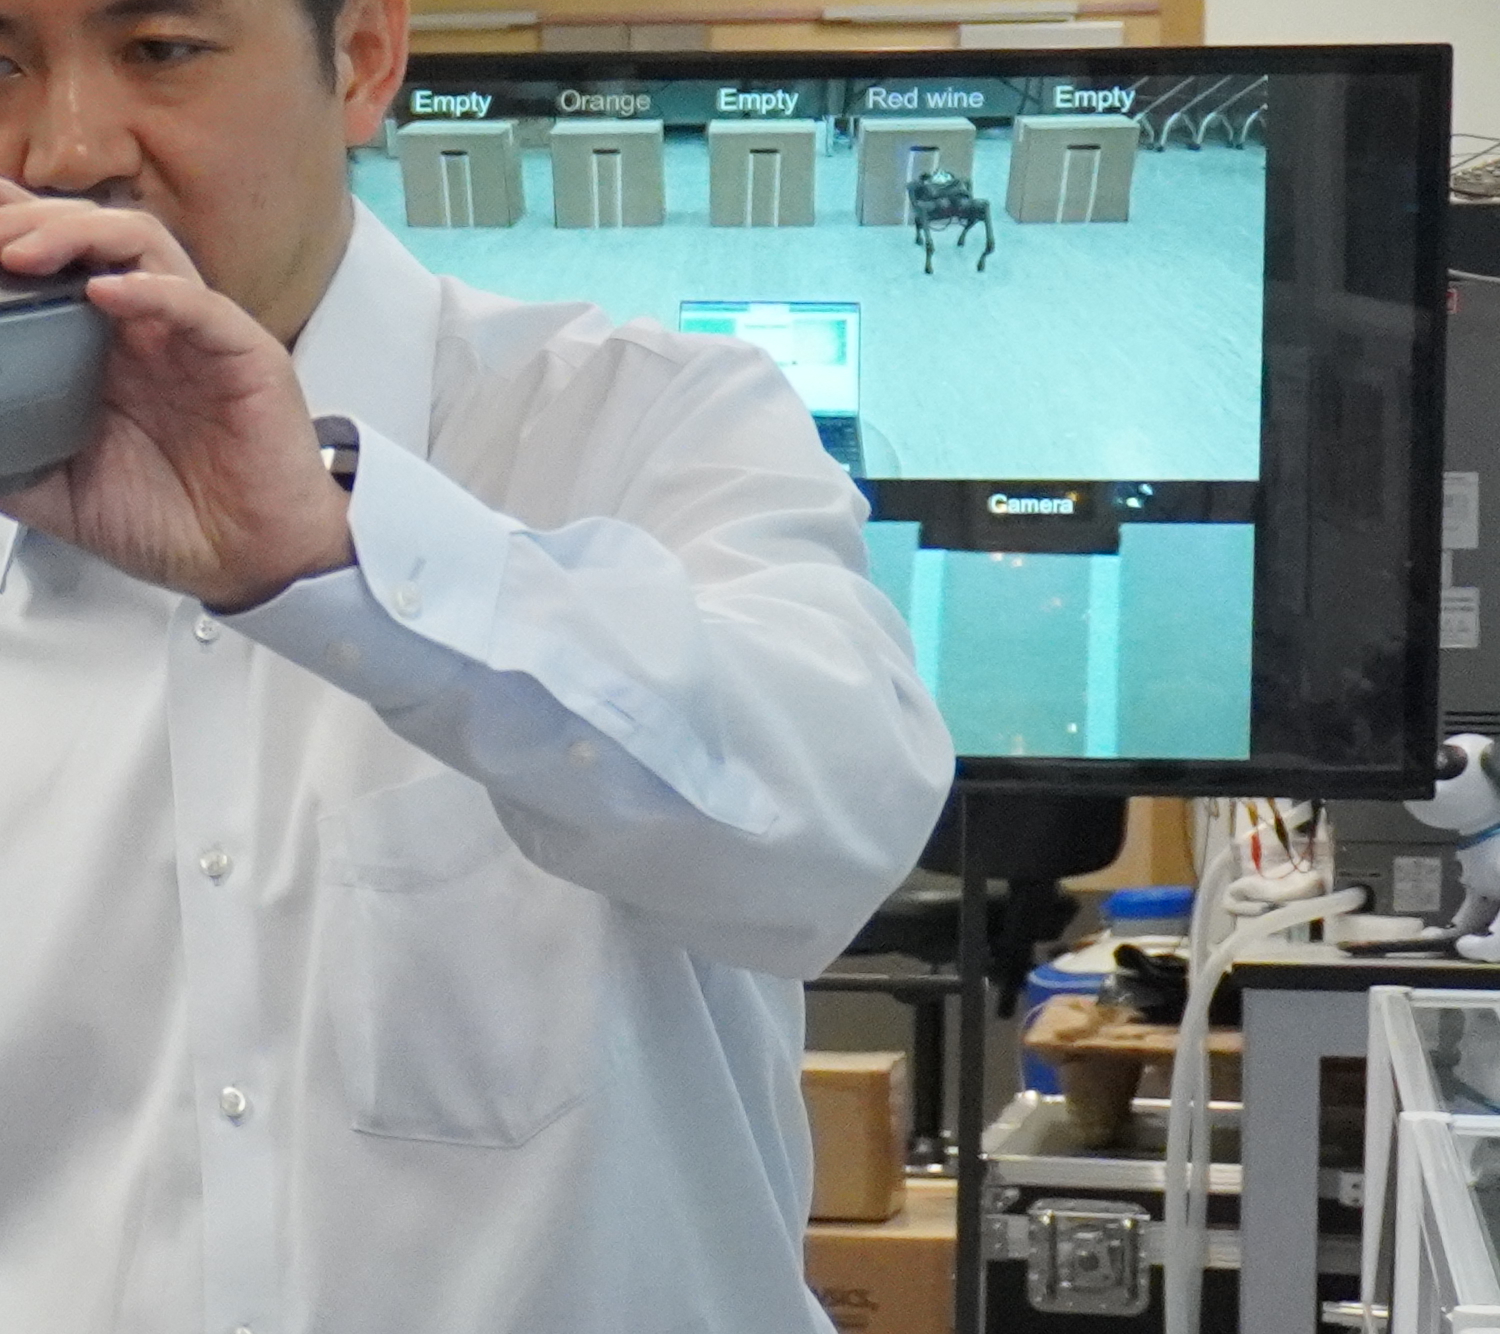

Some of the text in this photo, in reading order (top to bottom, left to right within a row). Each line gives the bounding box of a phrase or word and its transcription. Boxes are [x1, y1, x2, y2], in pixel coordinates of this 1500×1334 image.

[411, 89, 493, 118] Empty
[559, 89, 652, 114] Orange
[717, 88, 799, 117] Empty
[866, 86, 985, 109] Red wine
[1054, 84, 1136, 113] Empty
[988, 493, 1074, 515] Camera
